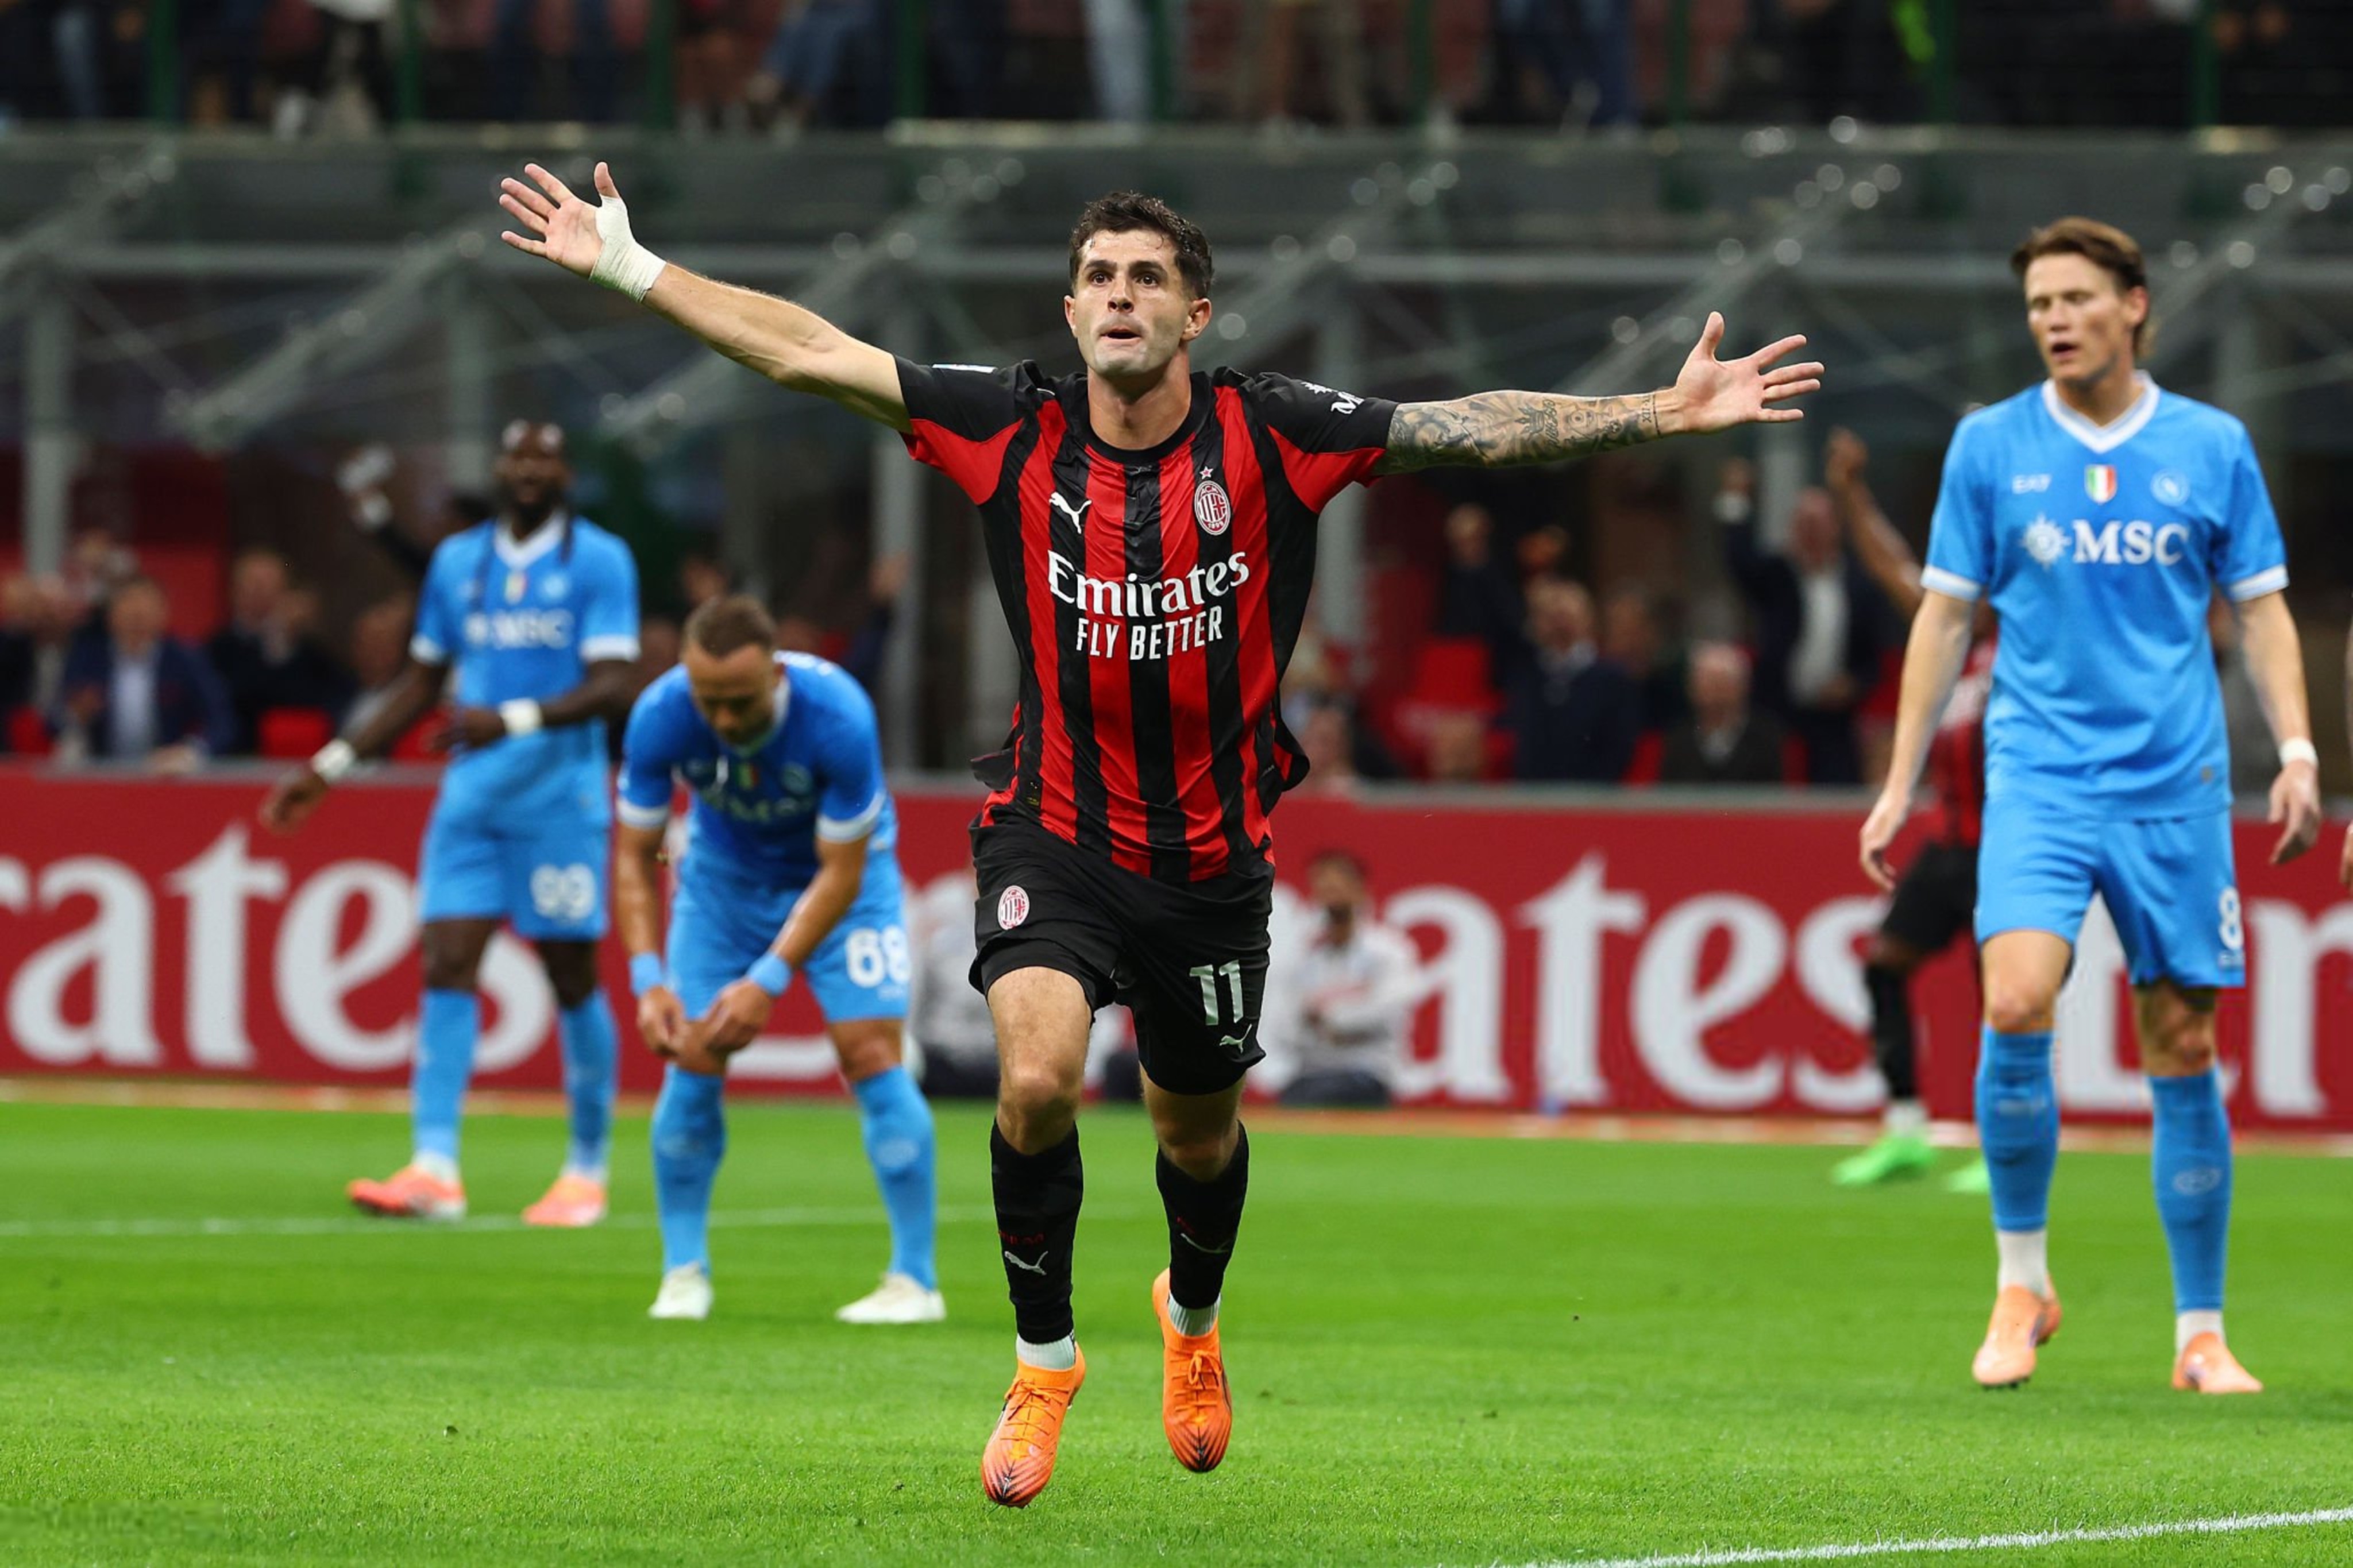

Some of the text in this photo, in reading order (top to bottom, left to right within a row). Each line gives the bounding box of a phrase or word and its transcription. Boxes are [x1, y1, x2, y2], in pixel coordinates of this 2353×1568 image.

[2073, 519, 2189, 566] MSC
[1048, 549, 1249, 617] Emirates
[1076, 605, 1223, 661] FLY BETTER
[2219, 886, 2244, 949] 8
[846, 925, 909, 988] 68
[1190, 959, 1244, 1025] 11
